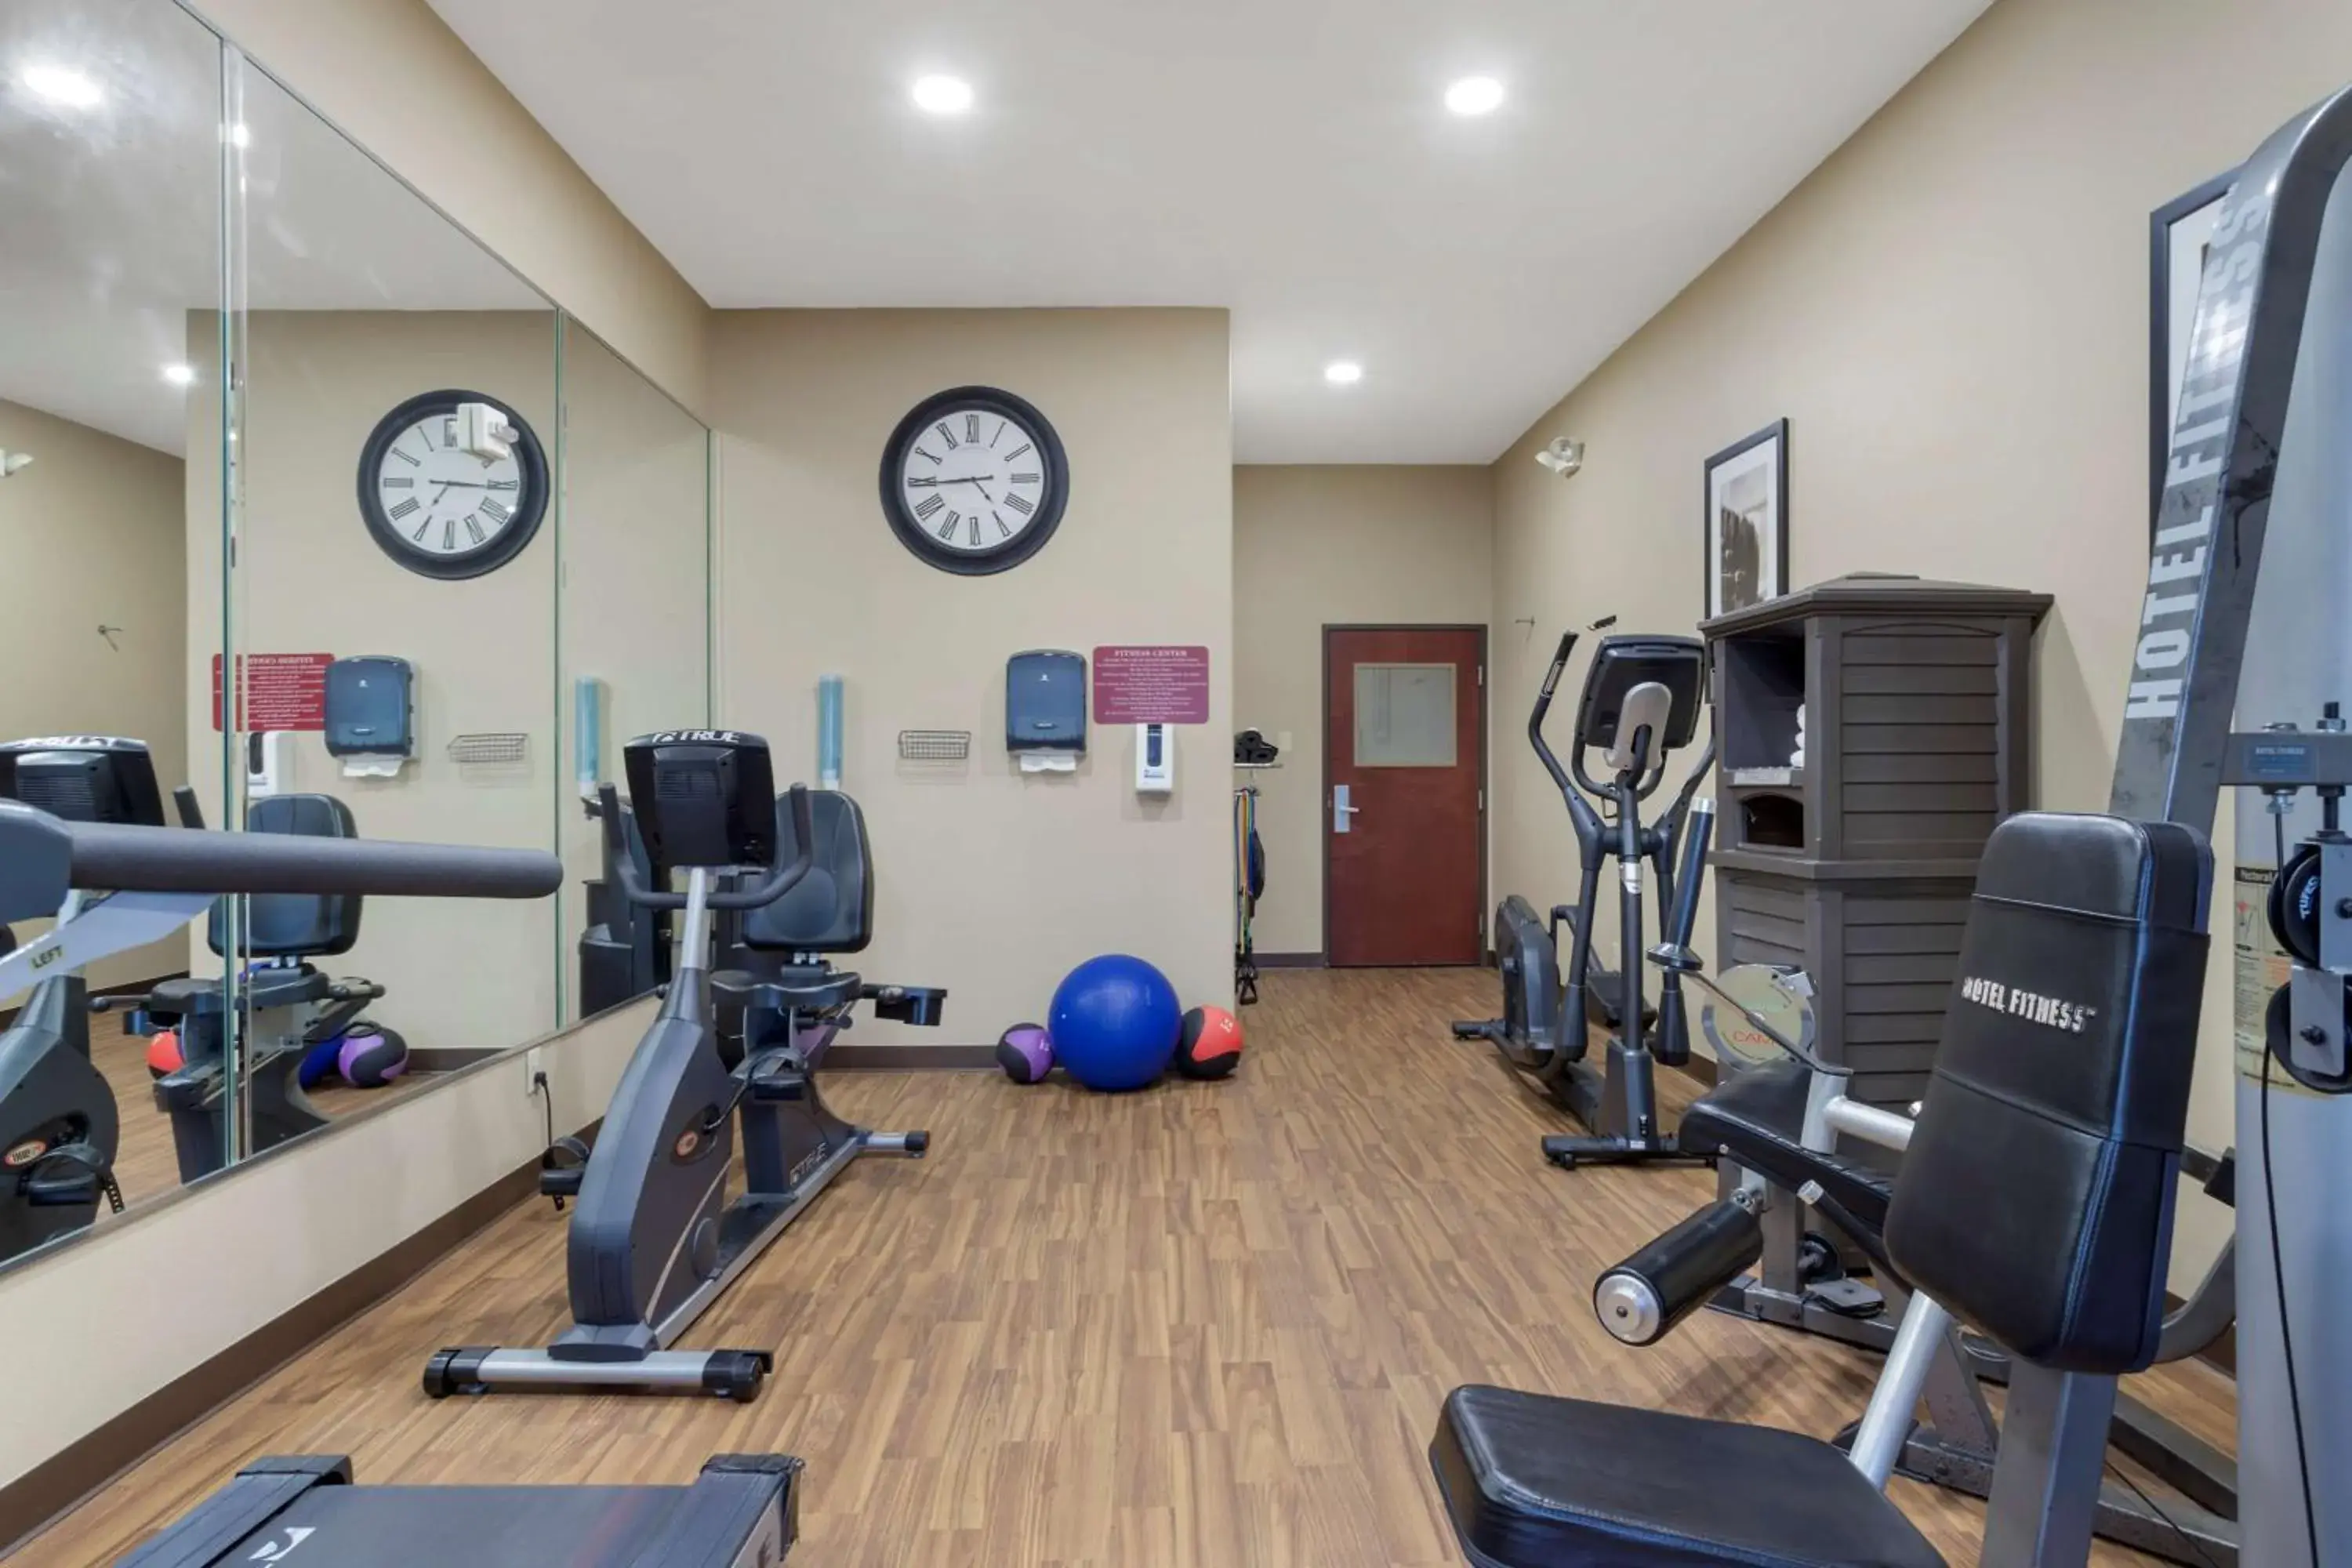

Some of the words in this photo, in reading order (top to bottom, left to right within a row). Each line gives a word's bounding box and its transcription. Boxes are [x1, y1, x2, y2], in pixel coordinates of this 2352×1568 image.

[965, 414, 980, 444] XII
[2126, 506, 2214, 719] HOTEL
[32, 944, 63, 969] LEFT
[1962, 976, 2005, 1013] HOTEL
